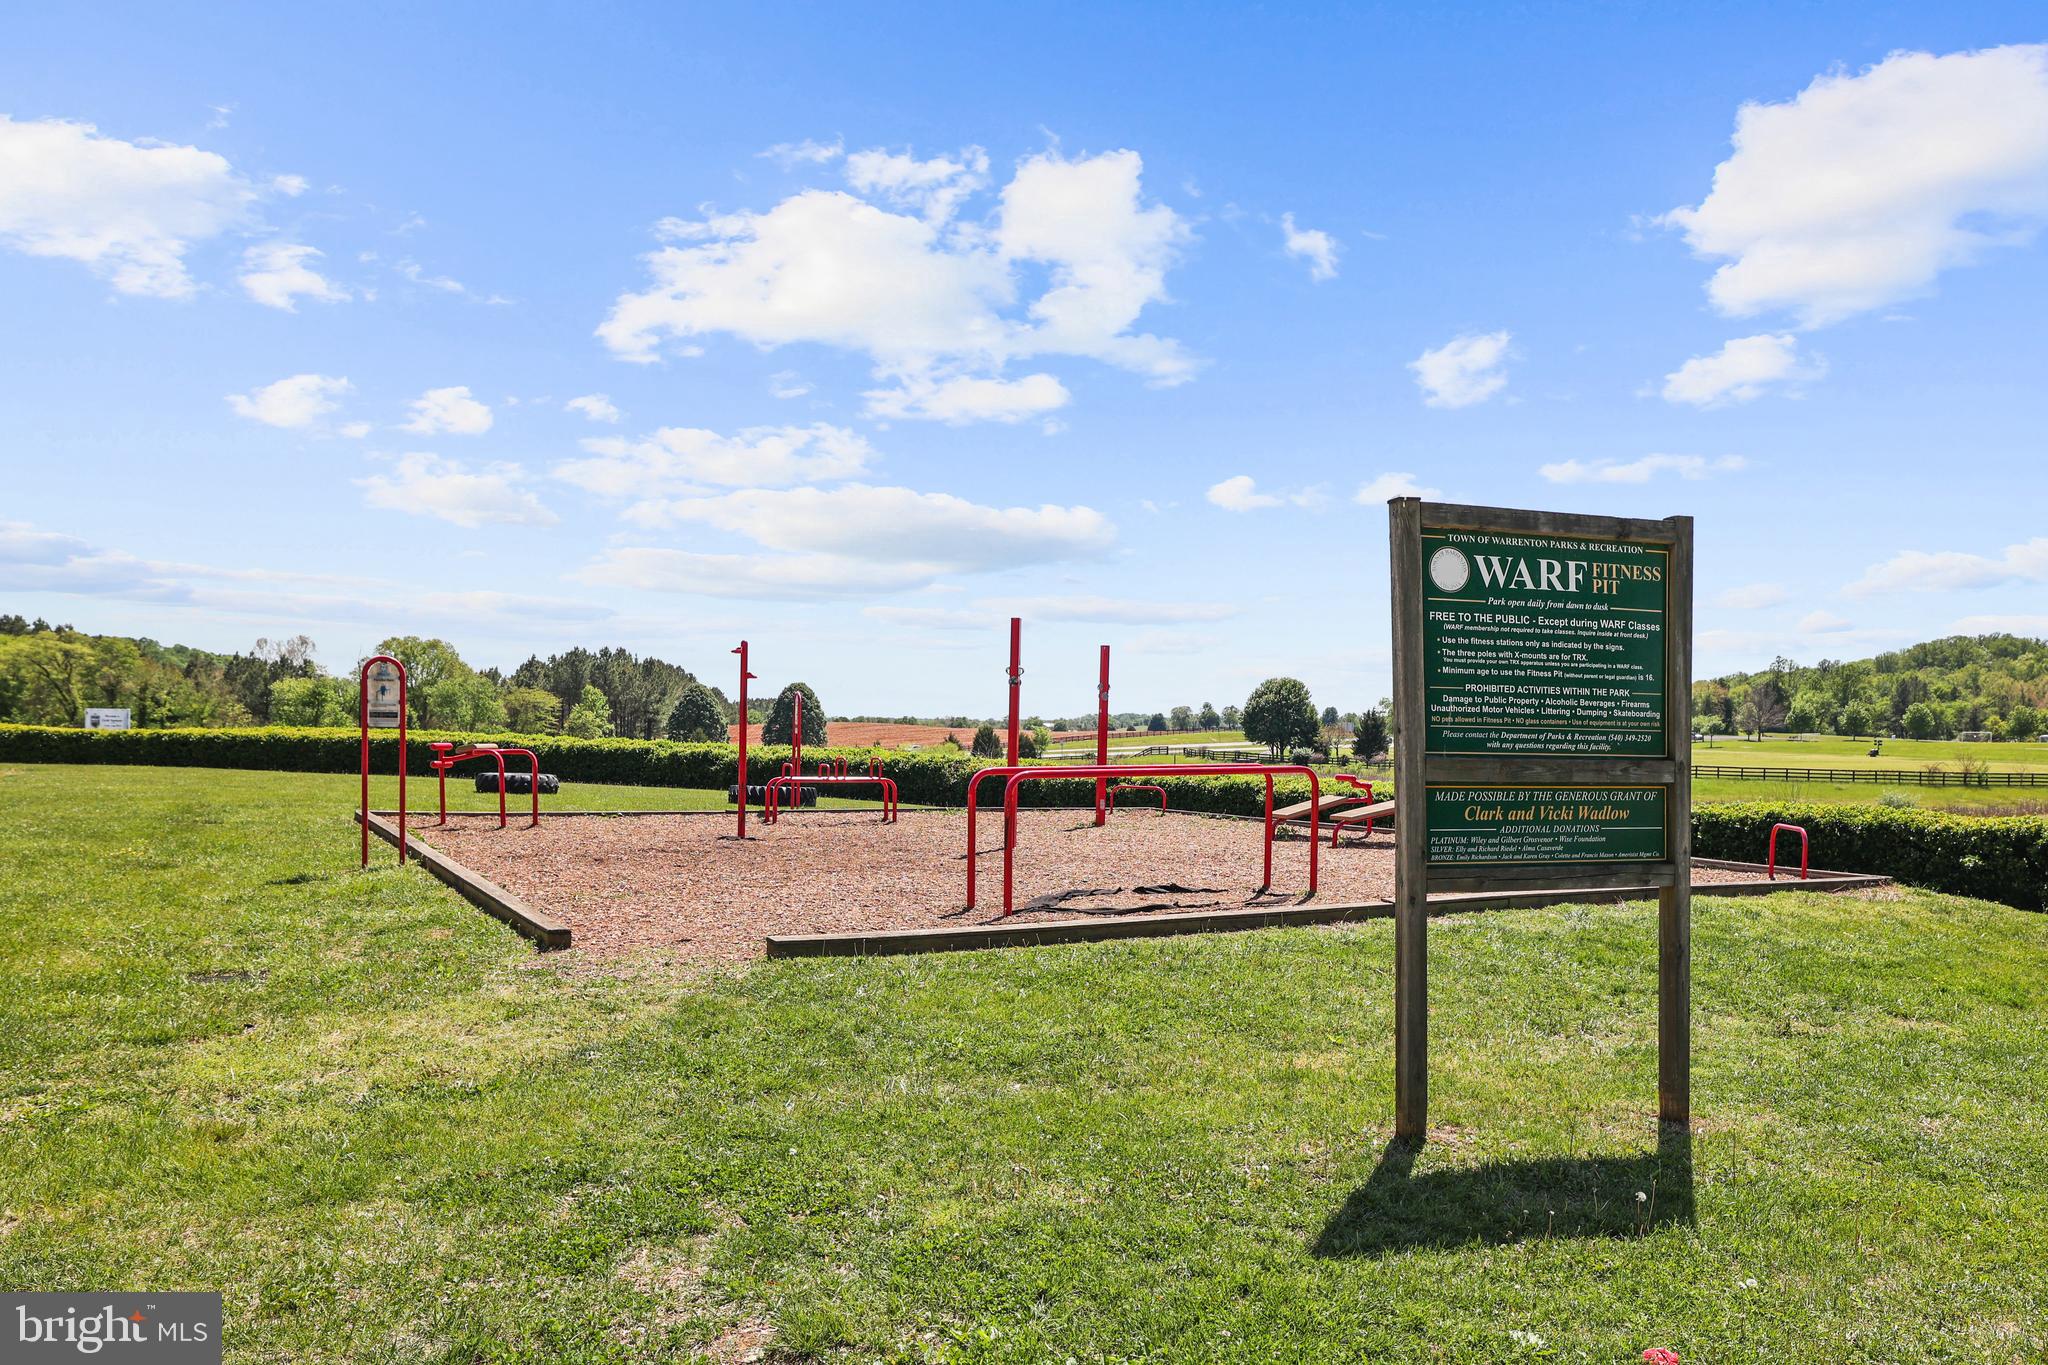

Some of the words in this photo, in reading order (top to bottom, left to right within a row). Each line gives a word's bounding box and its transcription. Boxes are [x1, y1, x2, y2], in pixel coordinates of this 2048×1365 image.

[1448, 534, 1475, 543] TOWN
[1491, 537, 1548, 548] WARRENTON
[1550, 540, 1578, 549] PARKS
[1589, 543, 1643, 554] RECREATION
[1474, 555, 1588, 592] WARF
[1592, 562, 1661, 581] FITNESS
[1593, 579, 1620, 594] PIT
[1488, 597, 1505, 606] Park
[1527, 599, 1545, 609] daily
[1545, 600, 1564, 609] from
[1593, 602, 1608, 610] dusk
[1430, 611, 1456, 621] FREE
[1458, 612, 1471, 621] TO
[1474, 613, 1492, 622] THE
[1496, 614, 1530, 624] PUBLIC
[1538, 616, 1568, 628] Except
[1570, 618, 1598, 629] during
[1600, 620, 1626, 628] WARF
[1628, 621, 1660, 631] Classes
[1525, 640, 1540, 648] only
[1606, 644, 1624, 652] signs.
[1514, 651, 1547, 659] X-mounts
[1465, 684, 1515, 693] PROHIBITED
[1517, 686, 1560, 694] ACTIVITIES
[1562, 687, 1590, 695] WITHIN
[1592, 688, 1607, 696] THE
[1443, 694, 1473, 704] Damage
[1484, 696, 1506, 704] Public
[1508, 697, 1539, 706] Property
[1580, 699, 1615, 708] Beverages
[1541, 707, 1570, 716] Littering
[1577, 708, 1607, 717] Dumping
[1613, 709, 1660, 719] Skateboarding
[1501, 732, 1537, 741] Department
[1435, 792, 1465, 801] MADE
[1468, 792, 1515, 801] POSSIBLE
[1518, 792, 1531, 801] BY
[1533, 792, 1553, 801] THE
[1555, 791, 1608, 801] GENEROUS
[1610, 791, 1642, 801] GRANT
[1644, 792, 1657, 801] OF
[1465, 806, 1504, 820] Clark
[1508, 806, 1535, 820] and
[1540, 806, 1573, 820] Vicki
[1578, 806, 1629, 820] Wadlow
[1471, 837, 1487, 846] Wiley
